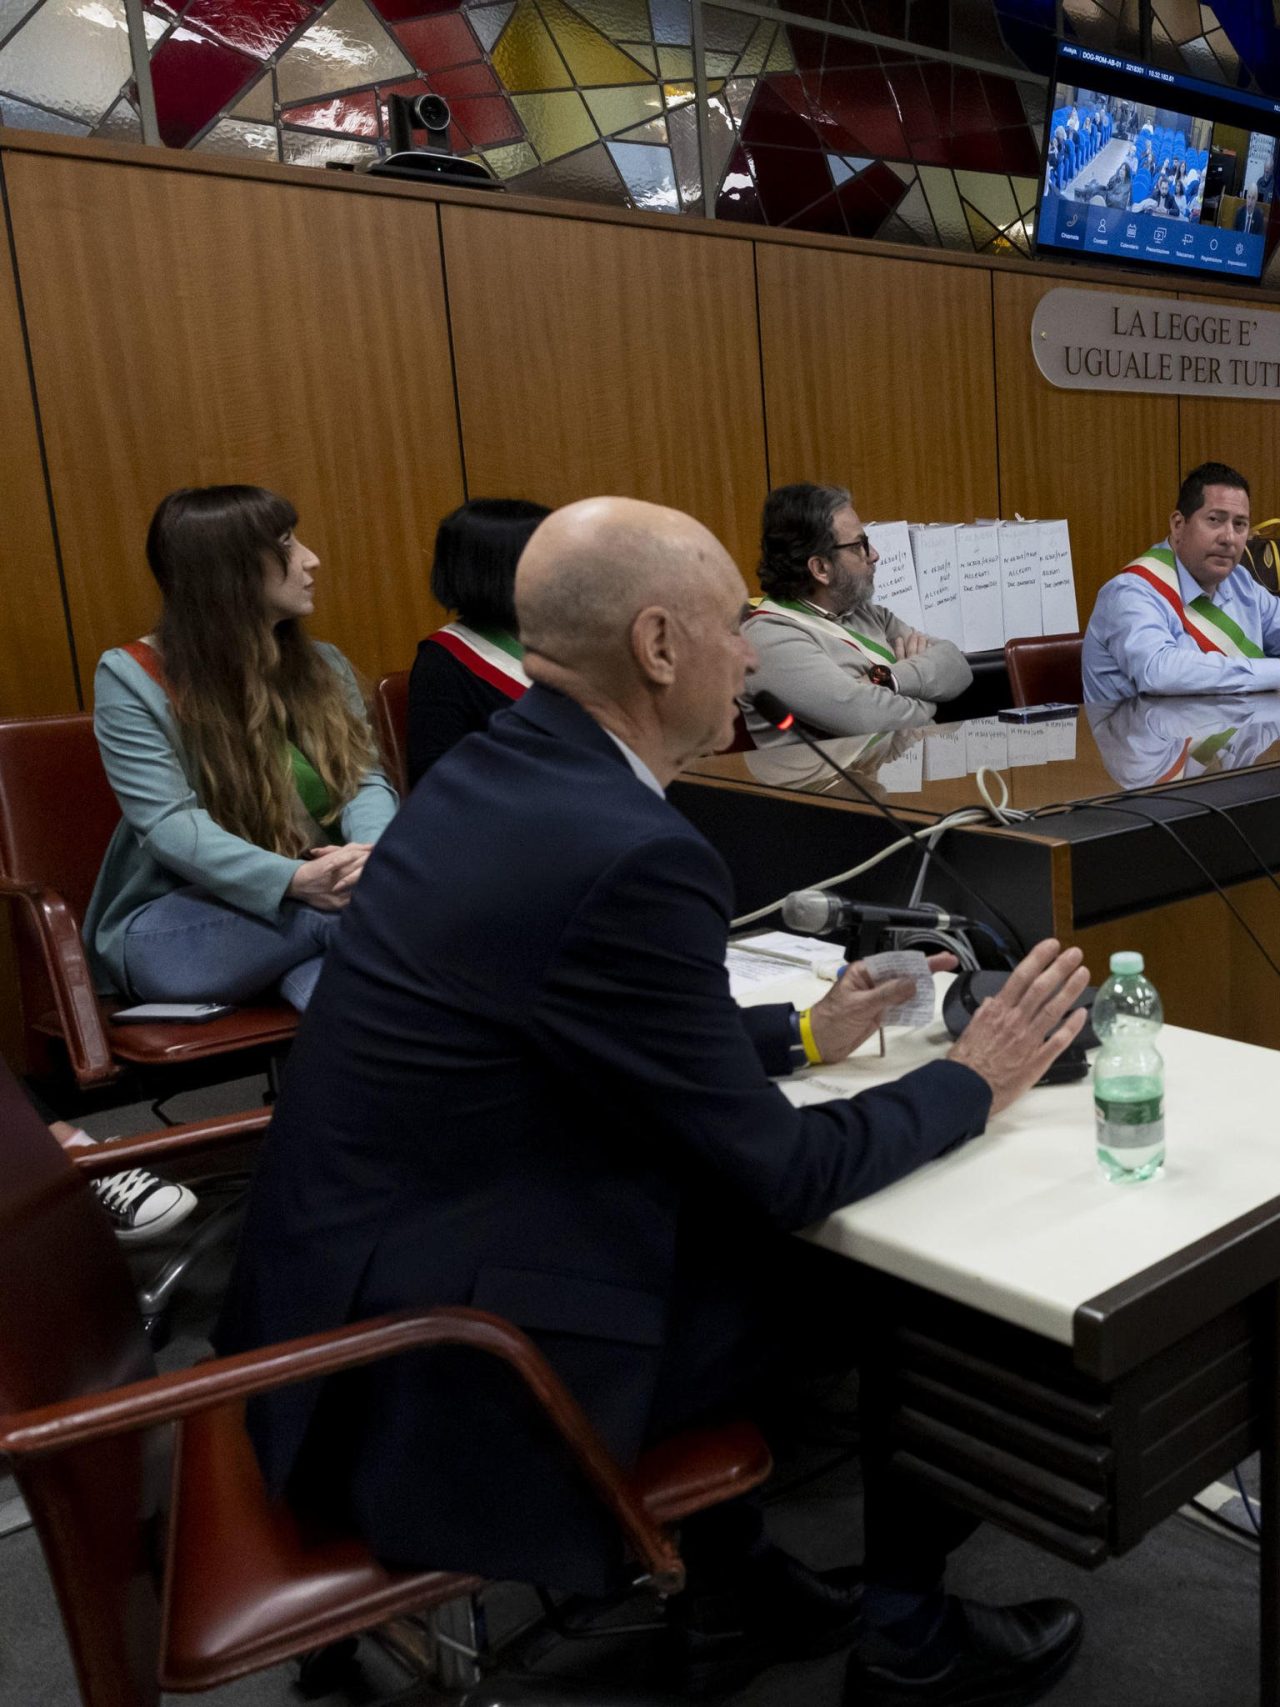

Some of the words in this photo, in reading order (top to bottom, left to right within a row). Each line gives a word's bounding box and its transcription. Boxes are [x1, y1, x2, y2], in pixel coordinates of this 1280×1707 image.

[1112, 306, 1147, 337] LA
[1153, 311, 1232, 346] LEGGE
[1064, 345, 1173, 382] UGUALE
[1180, 355, 1224, 385] PER
